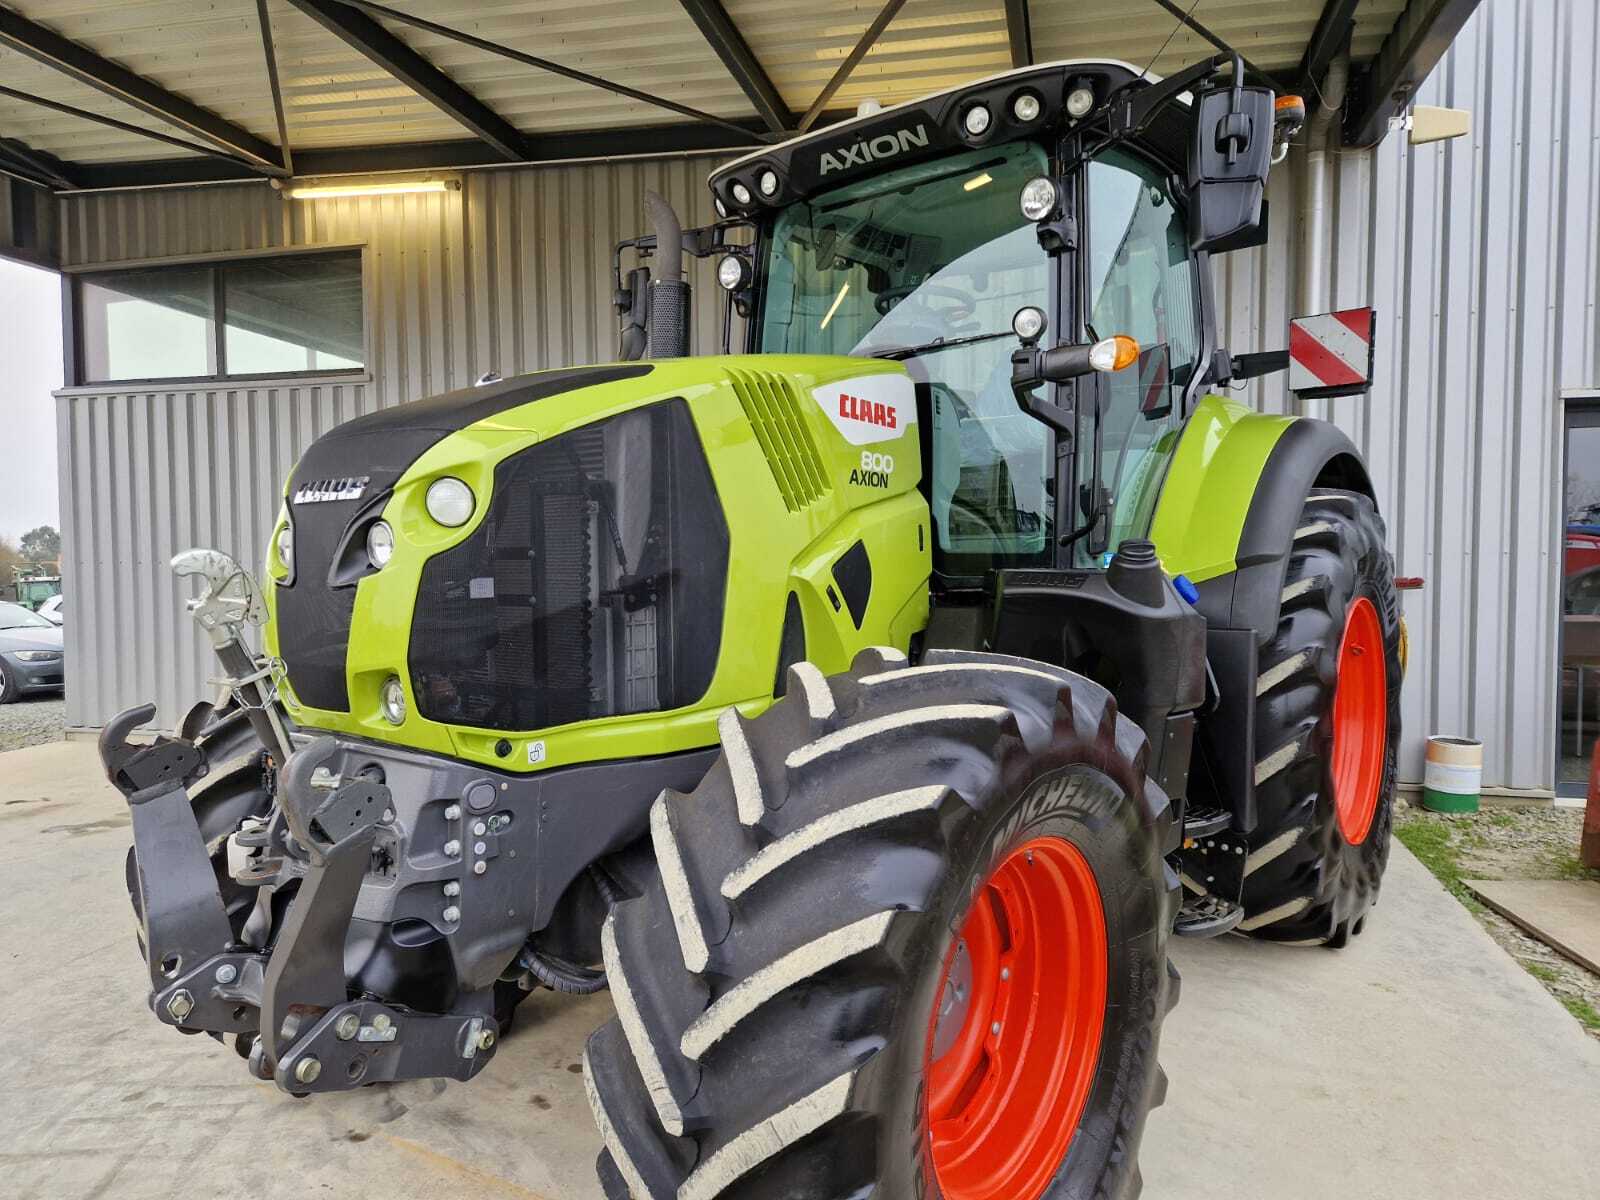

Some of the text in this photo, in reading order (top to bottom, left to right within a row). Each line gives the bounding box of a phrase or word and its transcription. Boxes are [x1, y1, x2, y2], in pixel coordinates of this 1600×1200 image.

[820, 124, 929, 176] AXION
[839, 393, 897, 430] CLAAS
[861, 450, 894, 475] 800
[849, 468, 889, 489] AXION
